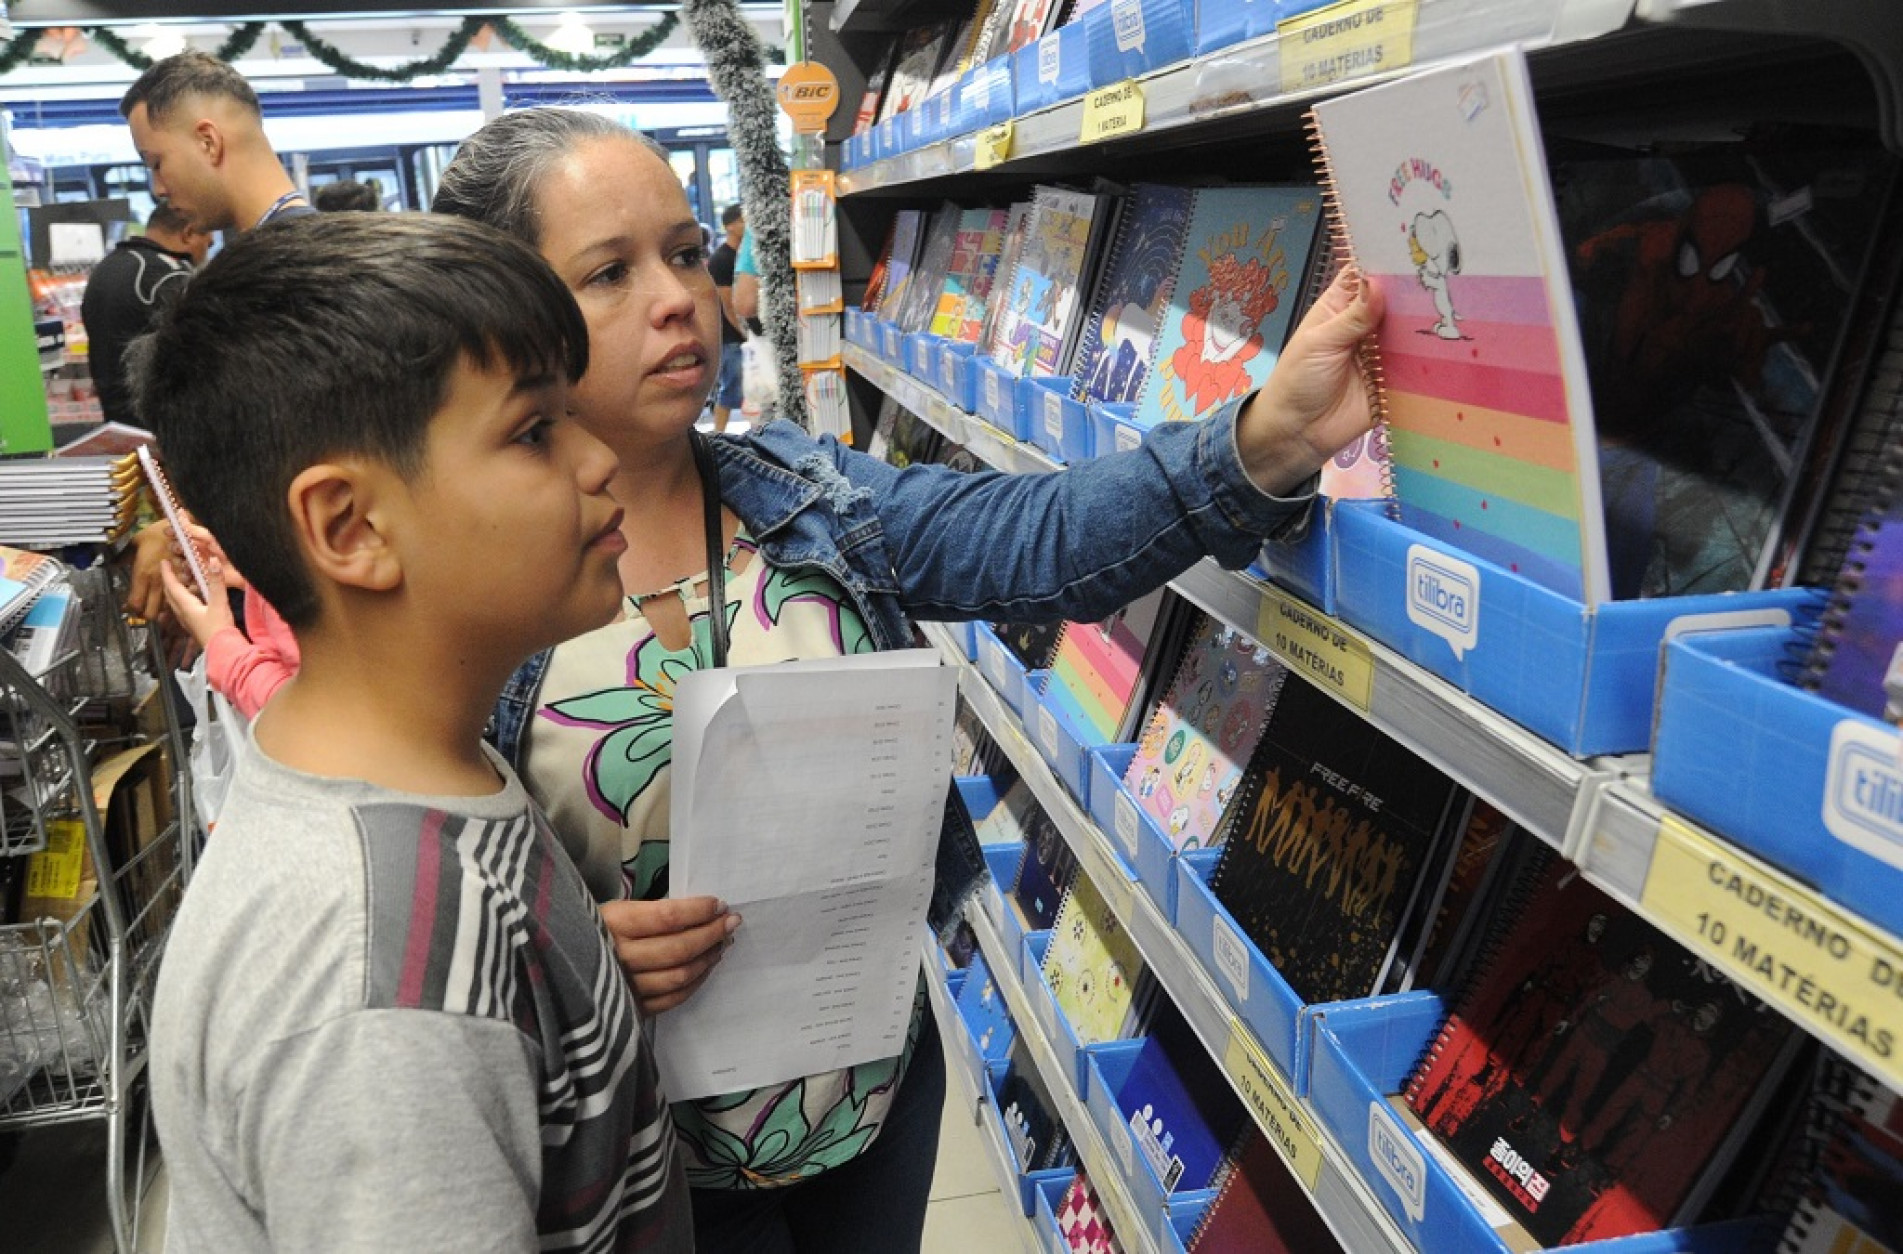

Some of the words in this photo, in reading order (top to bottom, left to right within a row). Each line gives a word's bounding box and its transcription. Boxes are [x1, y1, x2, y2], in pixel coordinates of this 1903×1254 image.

[1418, 573, 1465, 618] tilibra
[1276, 632, 1287, 650] 10
[1310, 762, 1349, 792] FREE
[1346, 783, 1383, 813] FIRE
[1708, 860, 1850, 960] CADERNO
[1696, 910, 1726, 945] 10
[1733, 935, 1894, 1058] MATÉRIAS
